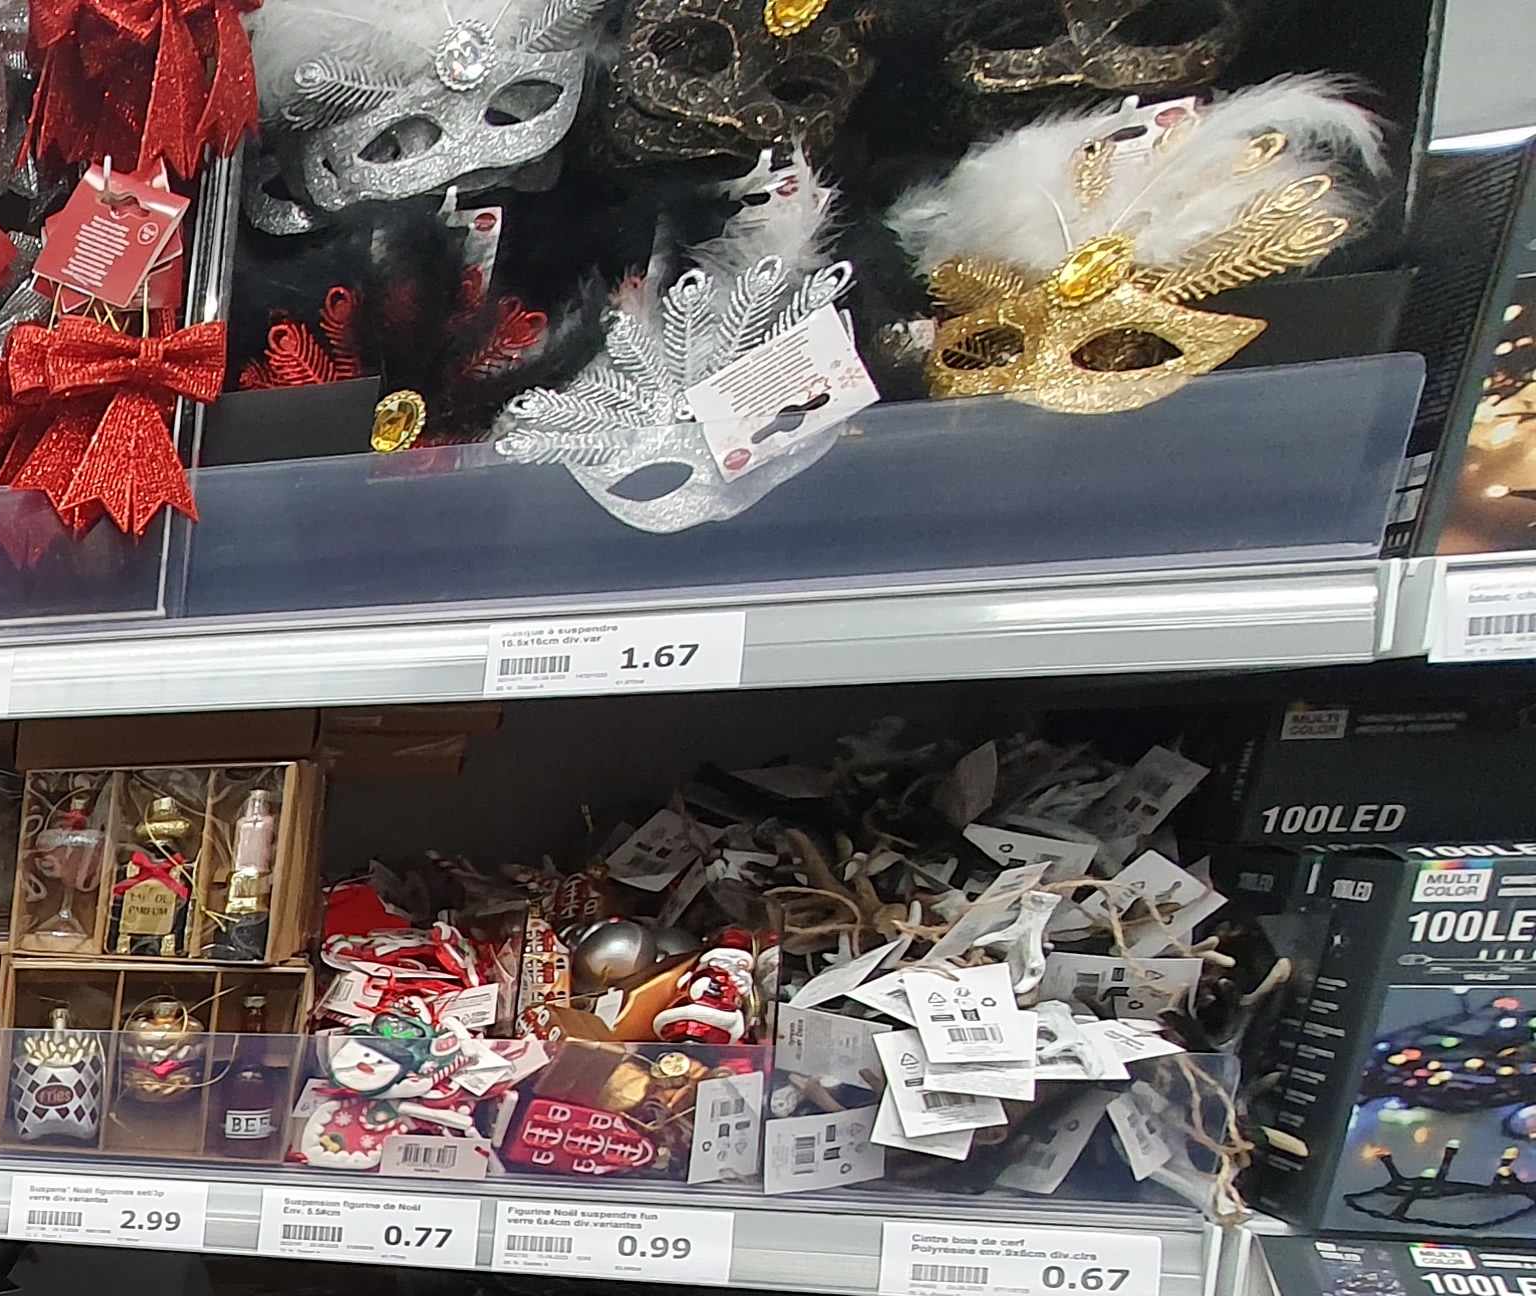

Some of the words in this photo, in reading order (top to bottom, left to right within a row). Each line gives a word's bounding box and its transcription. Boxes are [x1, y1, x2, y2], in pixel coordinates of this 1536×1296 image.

[558, 625, 618, 636] suspendre
[619, 643, 700, 670] 1.67
[1262, 804, 1407, 834] 100LED
[1426, 873, 1482, 885] MULTI
[1423, 885, 1479, 898] COLOR
[284, 1197, 340, 1209] Suspension
[343, 1200, 380, 1211] figurine
[382, 1202, 396, 1210] de
[398, 1202, 421, 1212] Noël
[119, 1209, 181, 1232] 2.99
[507, 1217, 534, 1225] verre
[508, 1206, 551, 1217] Figurine
[554, 1207, 578, 1217] Noël
[581, 1209, 637, 1221] suspendre
[640, 1211, 659, 1221] fun
[383, 1225, 454, 1249] 0.77
[911, 1233, 948, 1244] Cintre
[952, 1235, 978, 1245] bois
[982, 1237, 996, 1246] de
[1000, 1238, 1026, 1247] cerf
[617, 1235, 692, 1260] 0.99
[1041, 1265, 1130, 1292] 0.67
